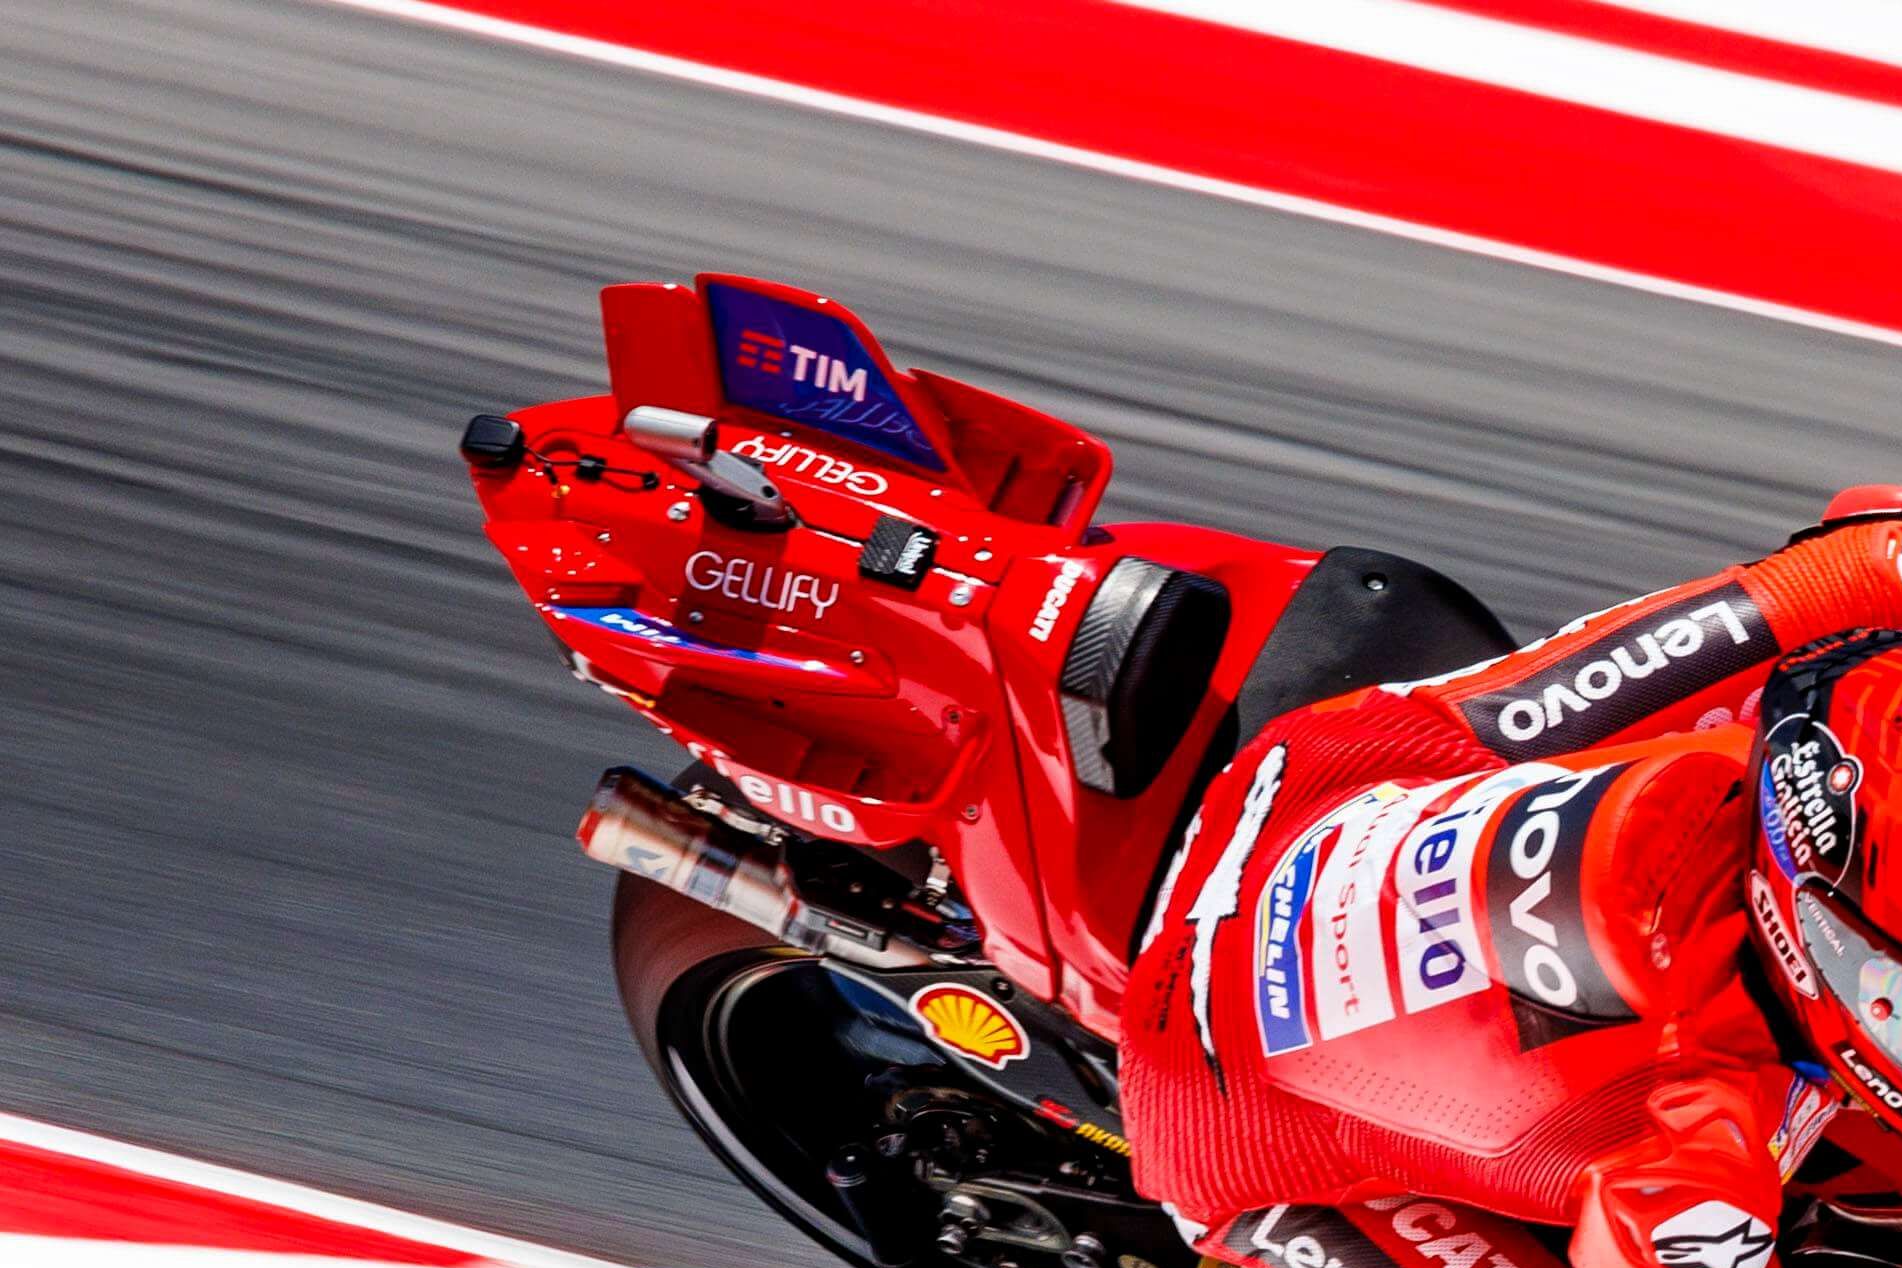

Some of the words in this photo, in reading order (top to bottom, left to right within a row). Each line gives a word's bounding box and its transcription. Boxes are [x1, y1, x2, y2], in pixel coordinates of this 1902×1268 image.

[789, 345, 868, 402] TIM
[731, 435, 888, 495] GELLIFY
[685, 550, 839, 620] GELLIFY
[1028, 560, 1084, 642] DUCATI
[1498, 602, 1749, 742] Lenovo
[1771, 754, 1811, 865] Galicia
[1791, 740, 1837, 855] Estrella
[1414, 796, 1492, 990] iello
[1754, 890, 1808, 984] SHOEI
[1331, 883, 1360, 1015] Sport
